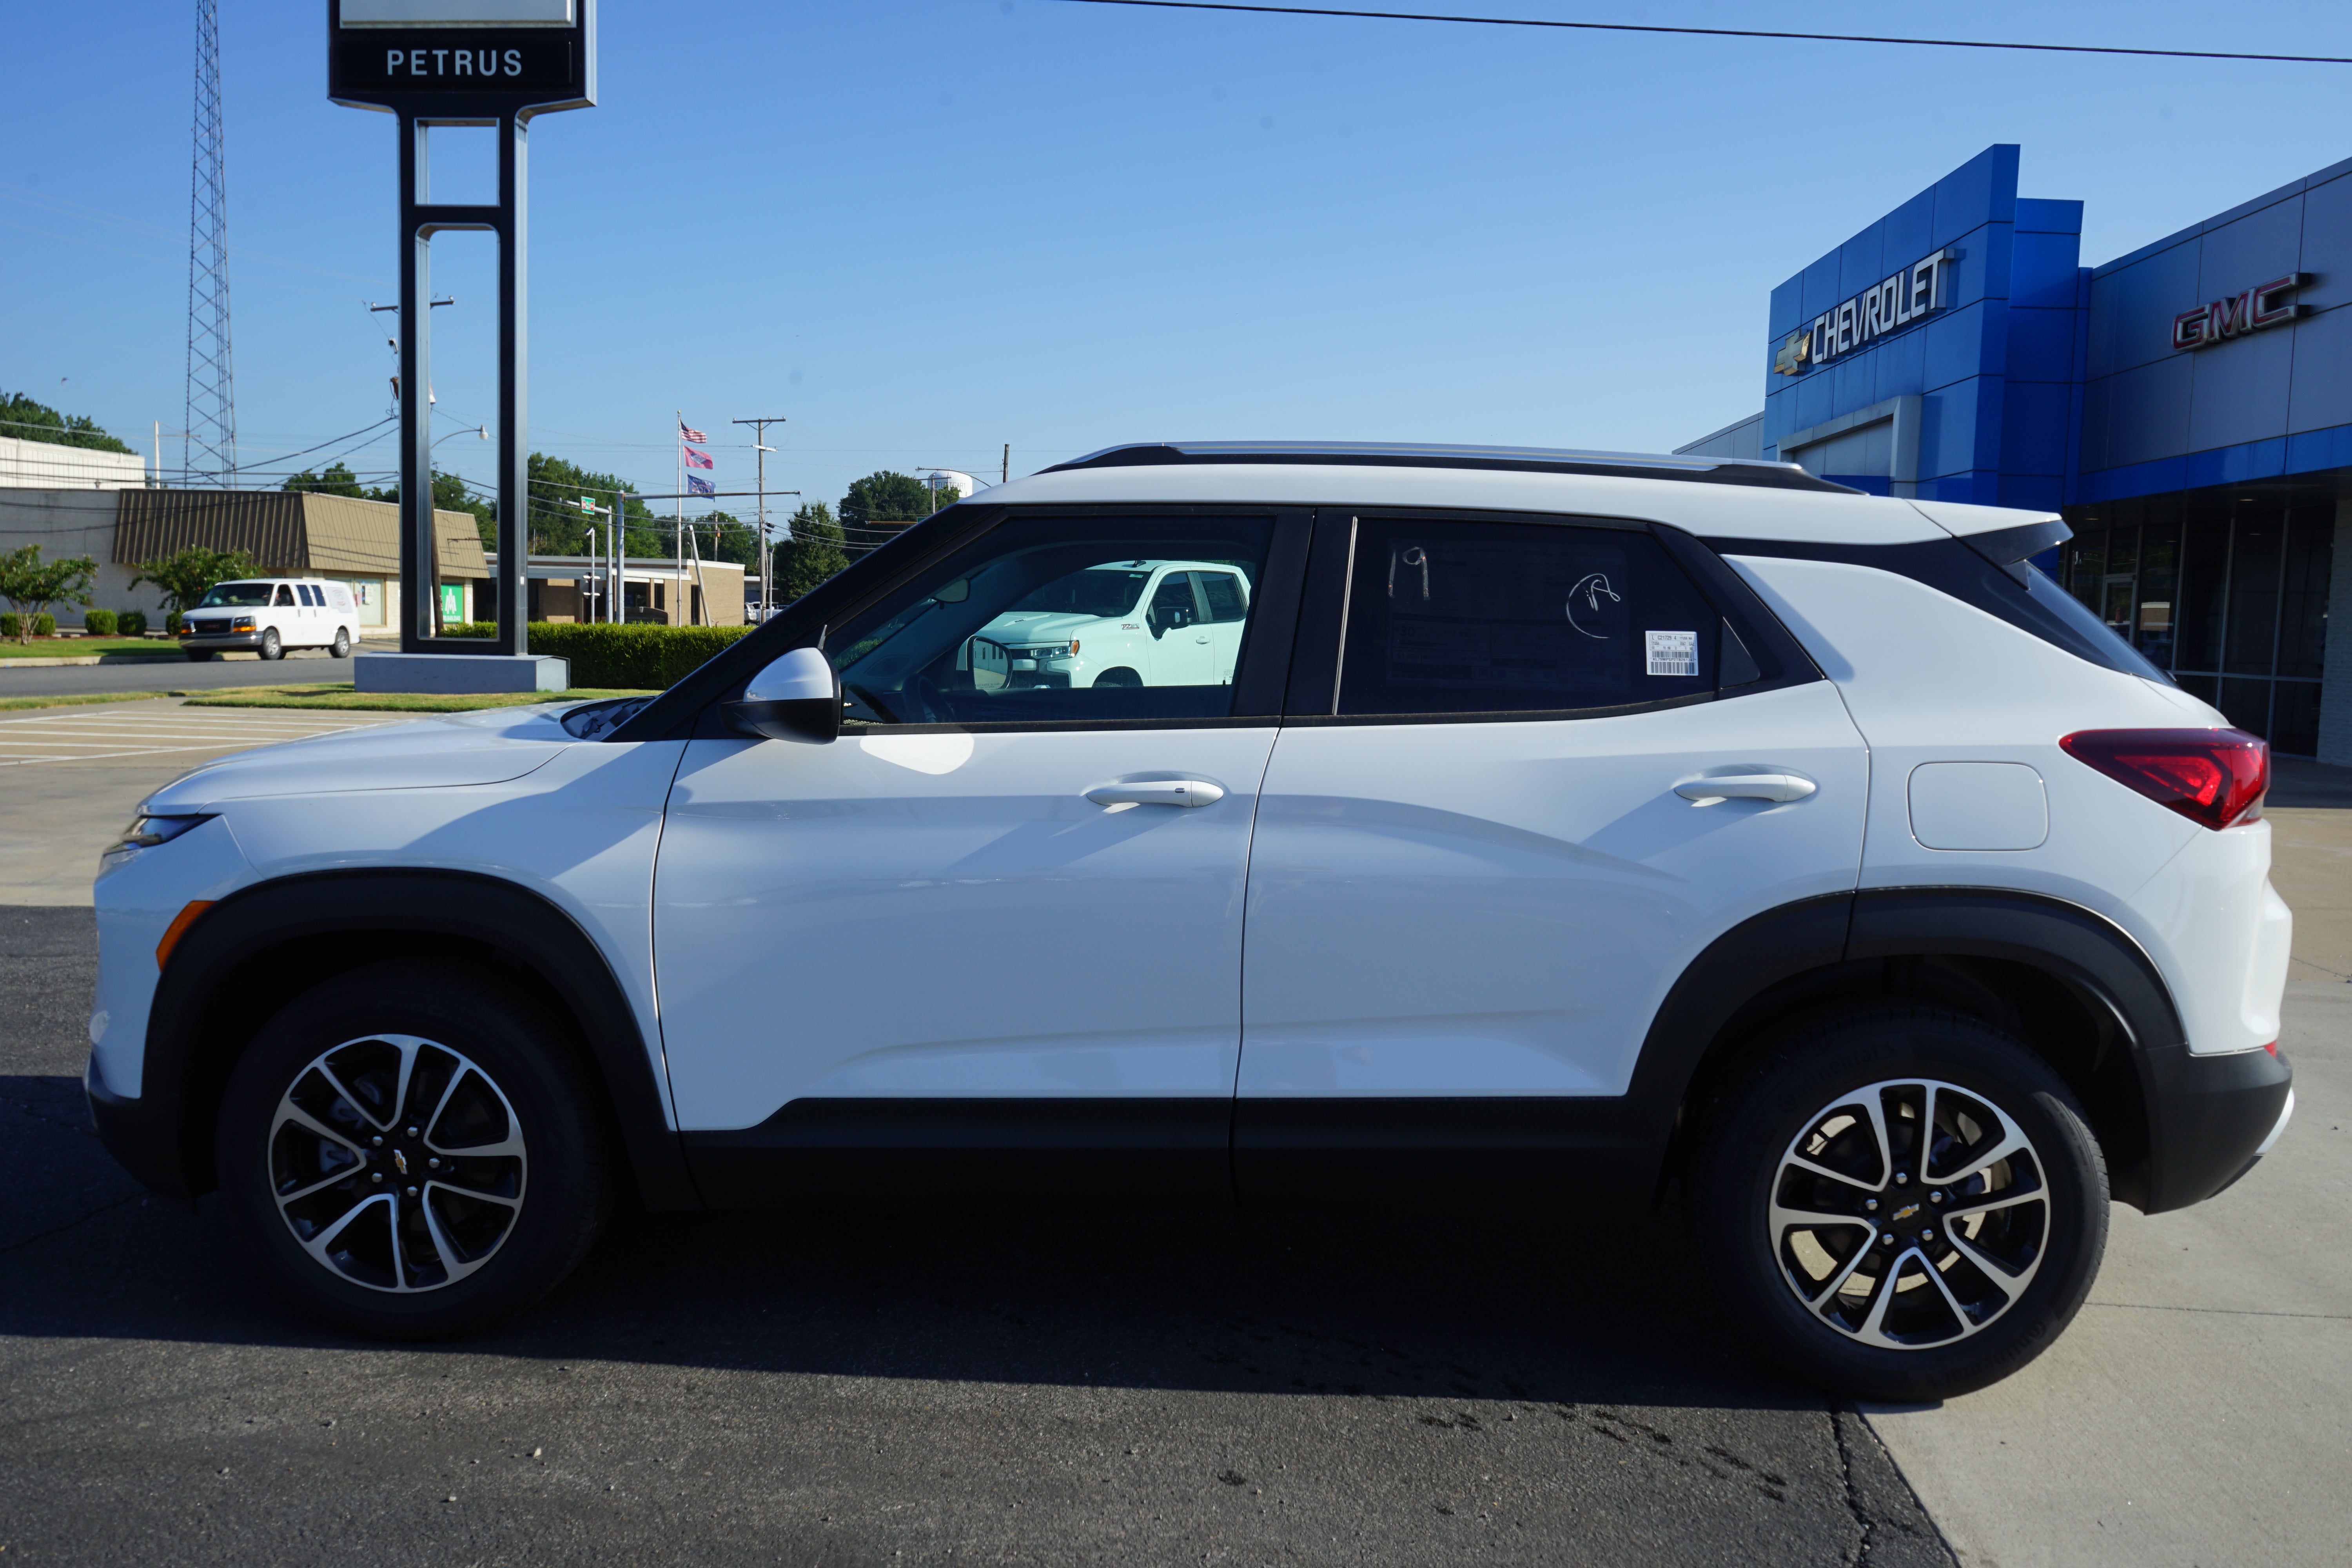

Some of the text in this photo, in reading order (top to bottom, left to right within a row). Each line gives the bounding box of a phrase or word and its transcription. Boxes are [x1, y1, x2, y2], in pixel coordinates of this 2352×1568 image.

[387, 49, 522, 76] PETRUS
[1812, 248, 1949, 365] CHEVROLET
[2172, 272, 2299, 352] GMC
[1388, 546, 1430, 600] 19
